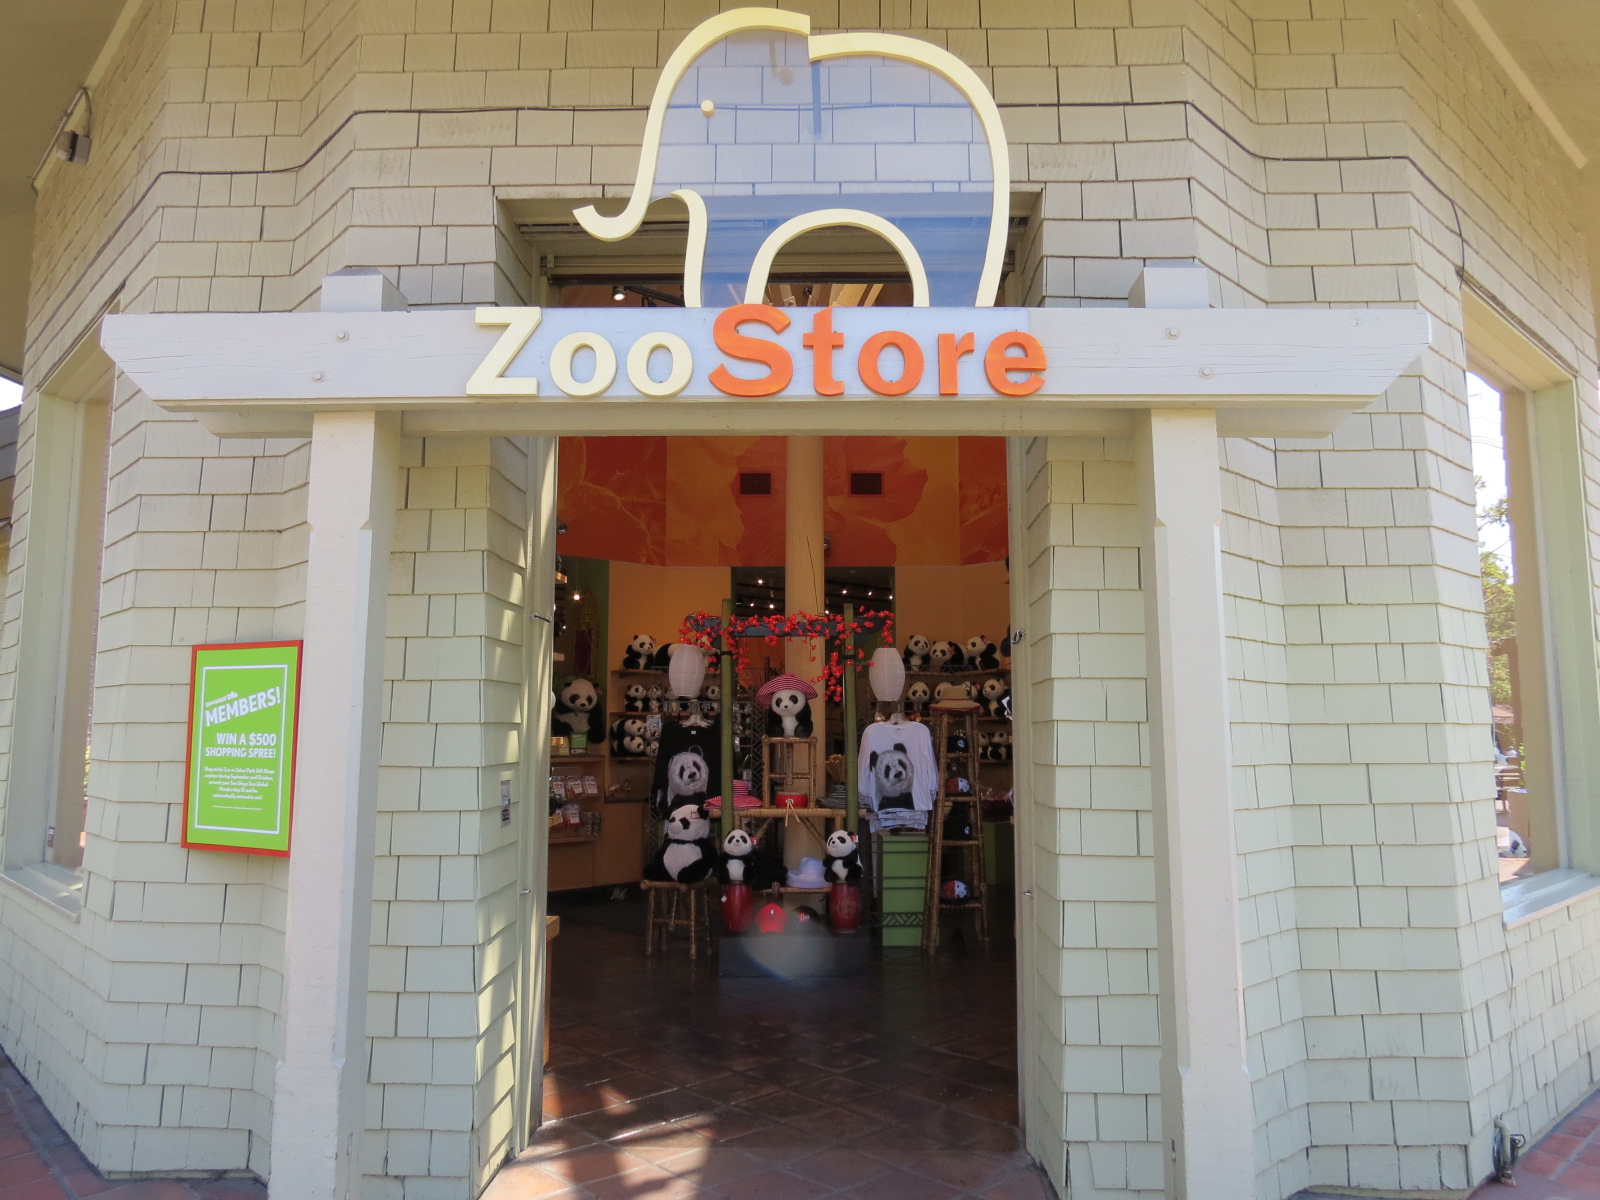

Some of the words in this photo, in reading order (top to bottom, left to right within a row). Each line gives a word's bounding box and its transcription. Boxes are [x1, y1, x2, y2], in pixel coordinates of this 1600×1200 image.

[205, 686, 281, 727] MEMBERS!
[216, 732, 237, 745] WIN
[239, 733, 247, 746] A
[249, 732, 277, 747] $500
[205, 747, 247, 758] SHOPPING
[248, 748, 277, 758] SPREE!
